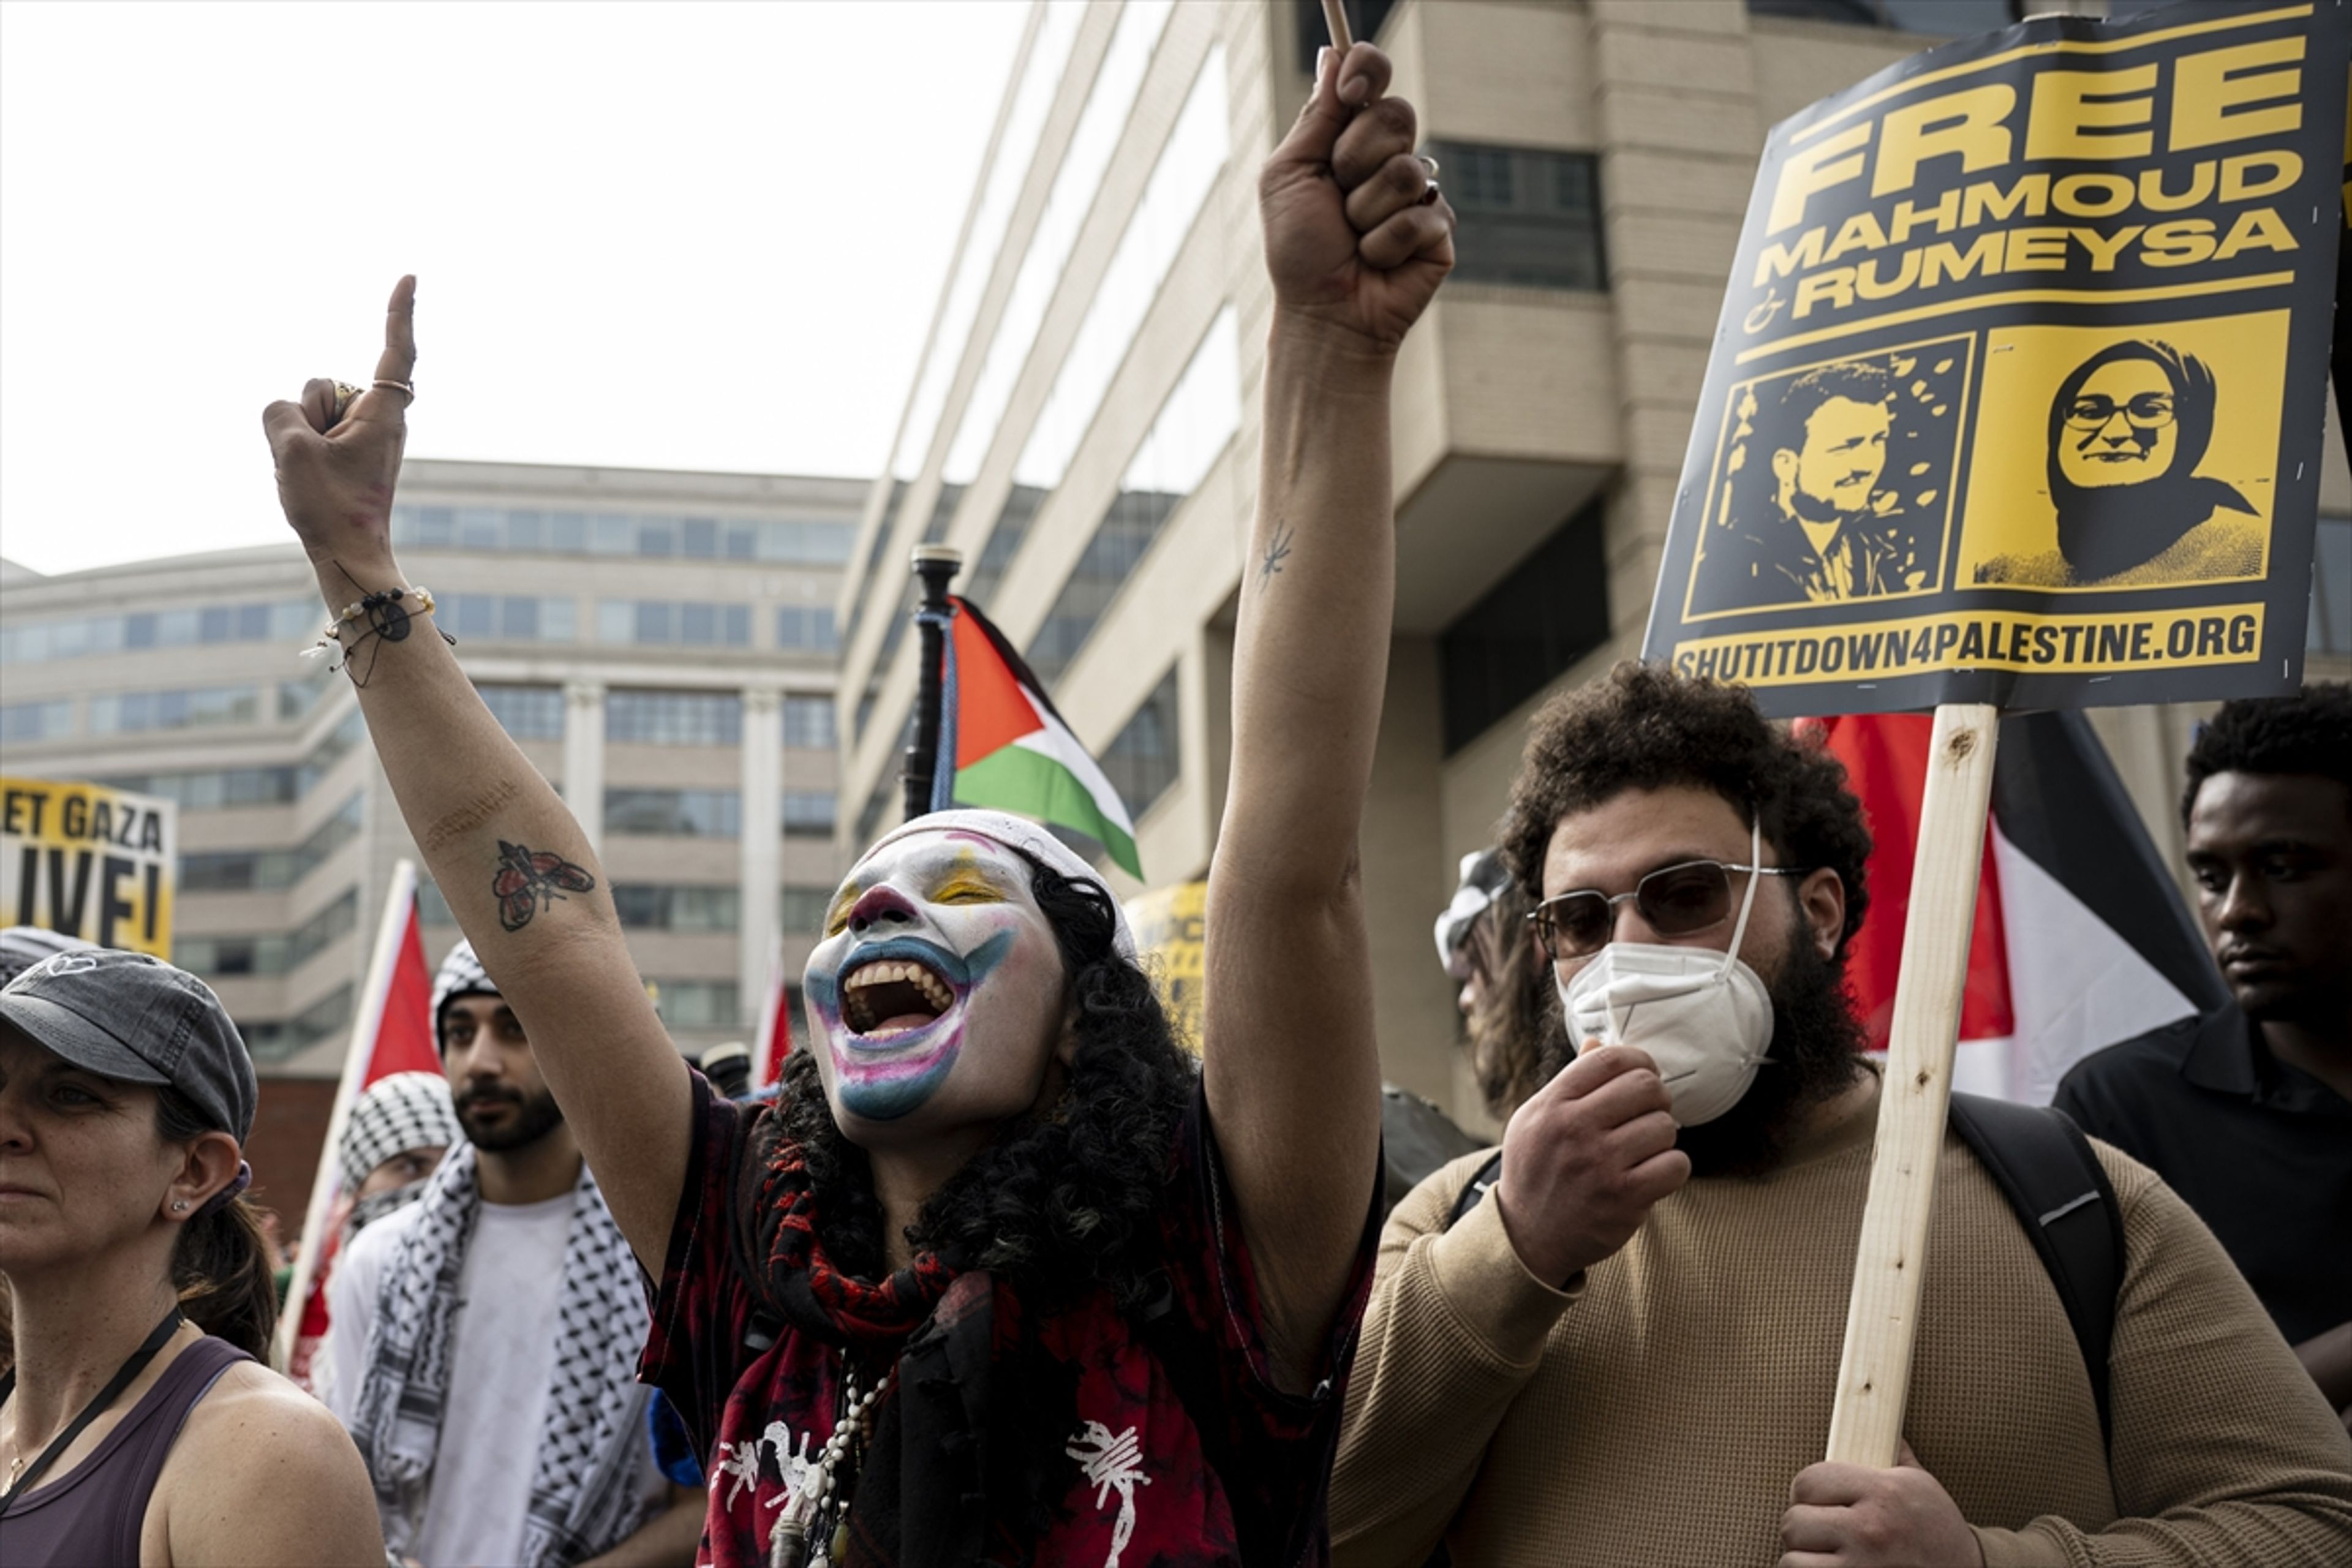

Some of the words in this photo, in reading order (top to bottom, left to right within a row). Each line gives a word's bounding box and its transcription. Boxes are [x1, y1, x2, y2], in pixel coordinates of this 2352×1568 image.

[1764, 35, 2307, 238] FREE
[1743, 287, 1787, 334] &
[1791, 207, 2300, 319] RUMEYSA
[1752, 149, 2304, 288] MAHMOUD
[1676, 614, 2256, 681] SHUTITDOWN4PALESTINE.ORG
[0, 789, 48, 837] ET
[63, 794, 162, 852] GAZA
